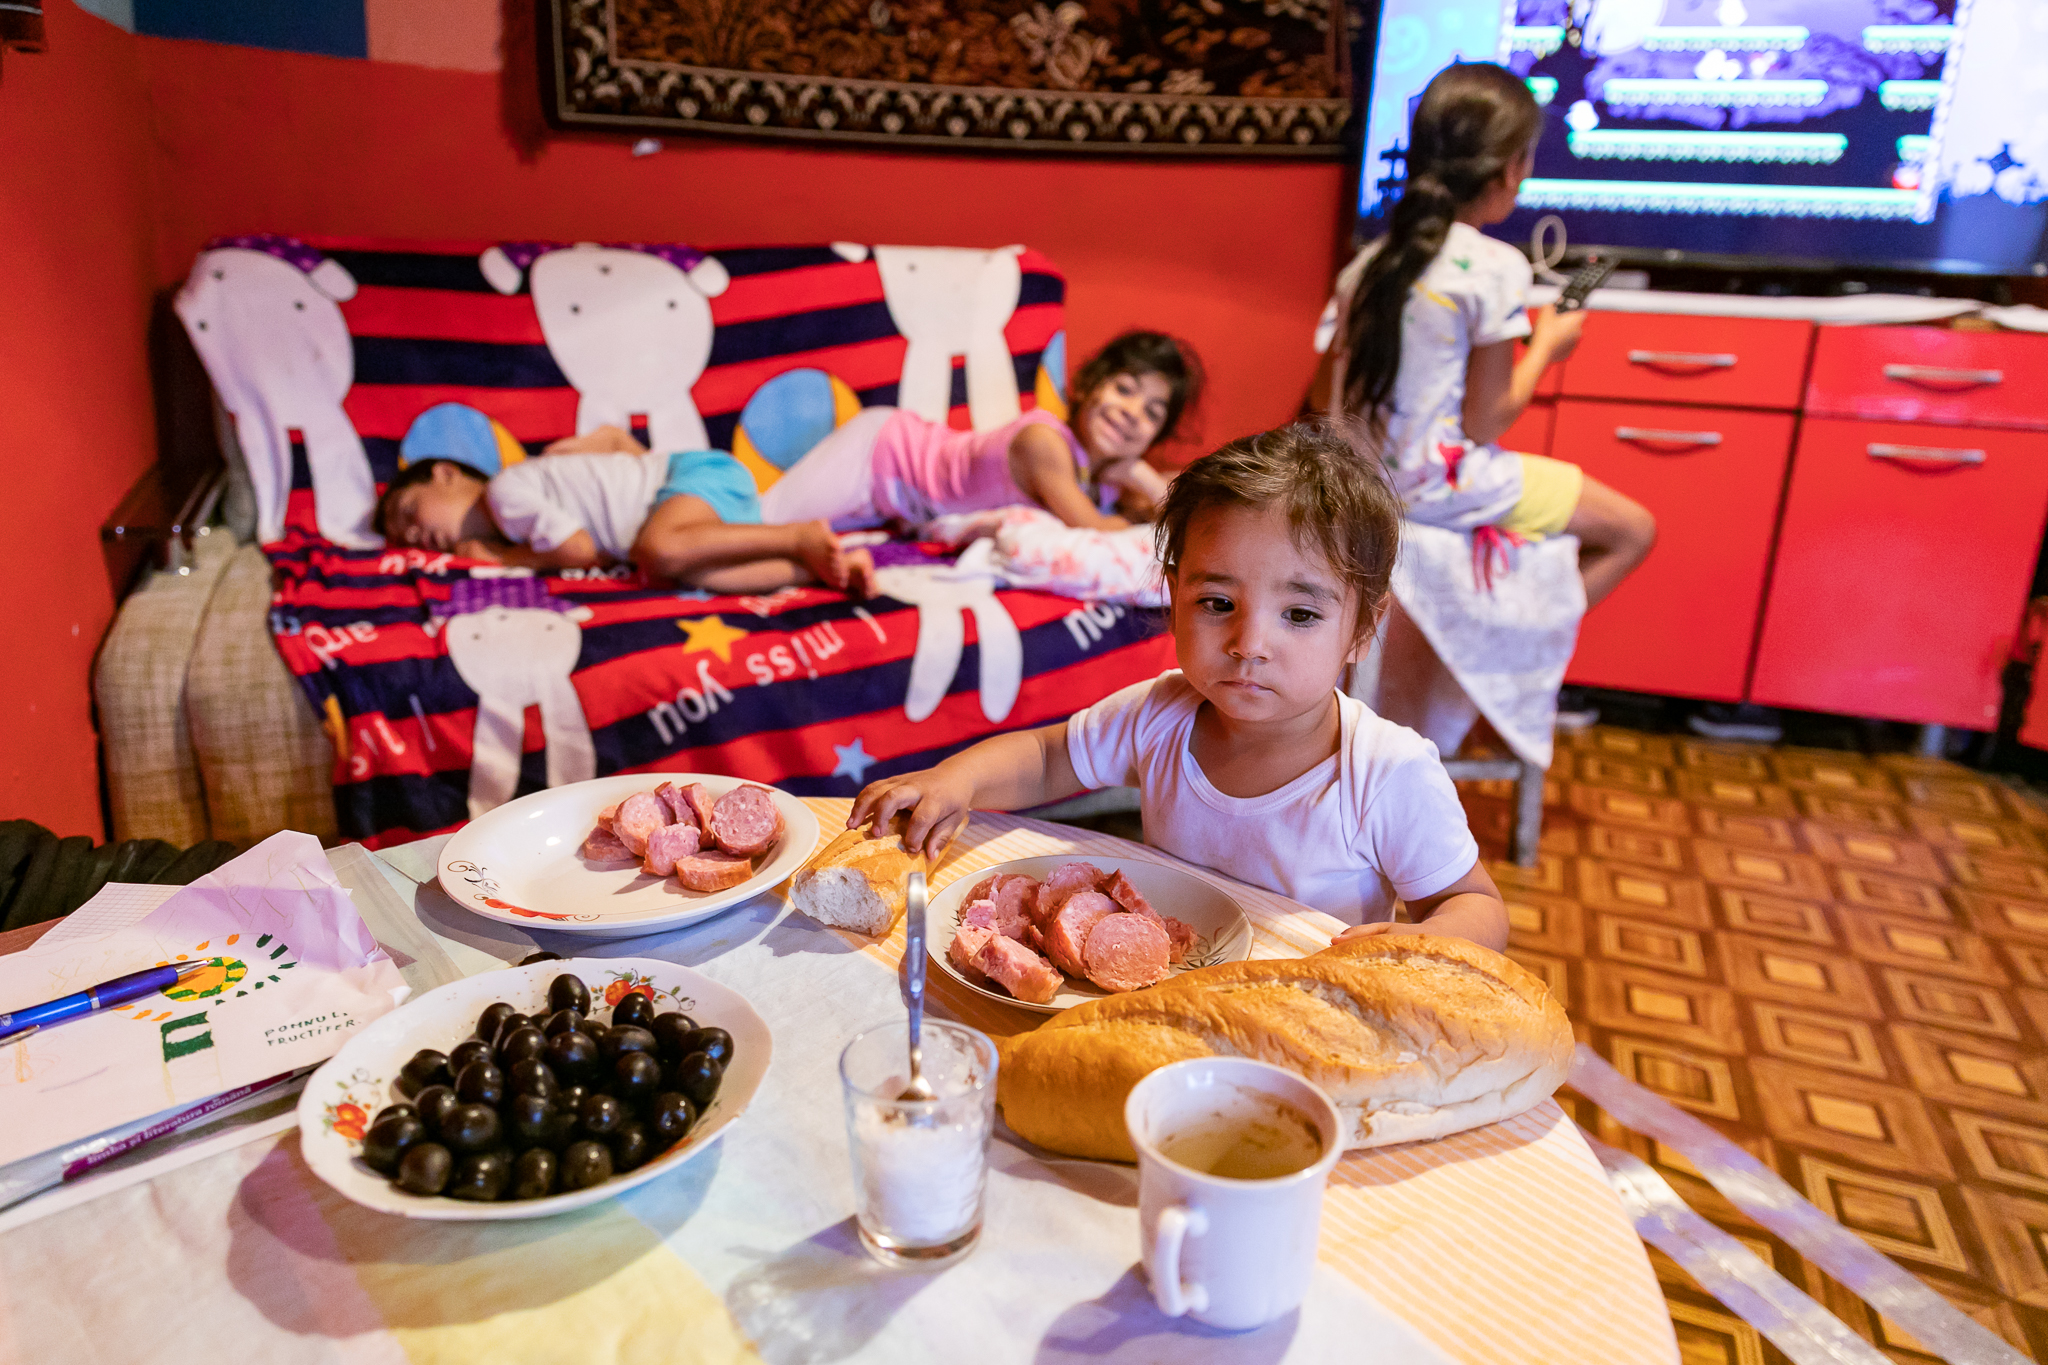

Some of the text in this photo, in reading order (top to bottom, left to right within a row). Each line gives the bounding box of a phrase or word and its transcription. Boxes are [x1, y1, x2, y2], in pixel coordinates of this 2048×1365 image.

[303, 620, 380, 671] and
[647, 606, 887, 746] I miss you
